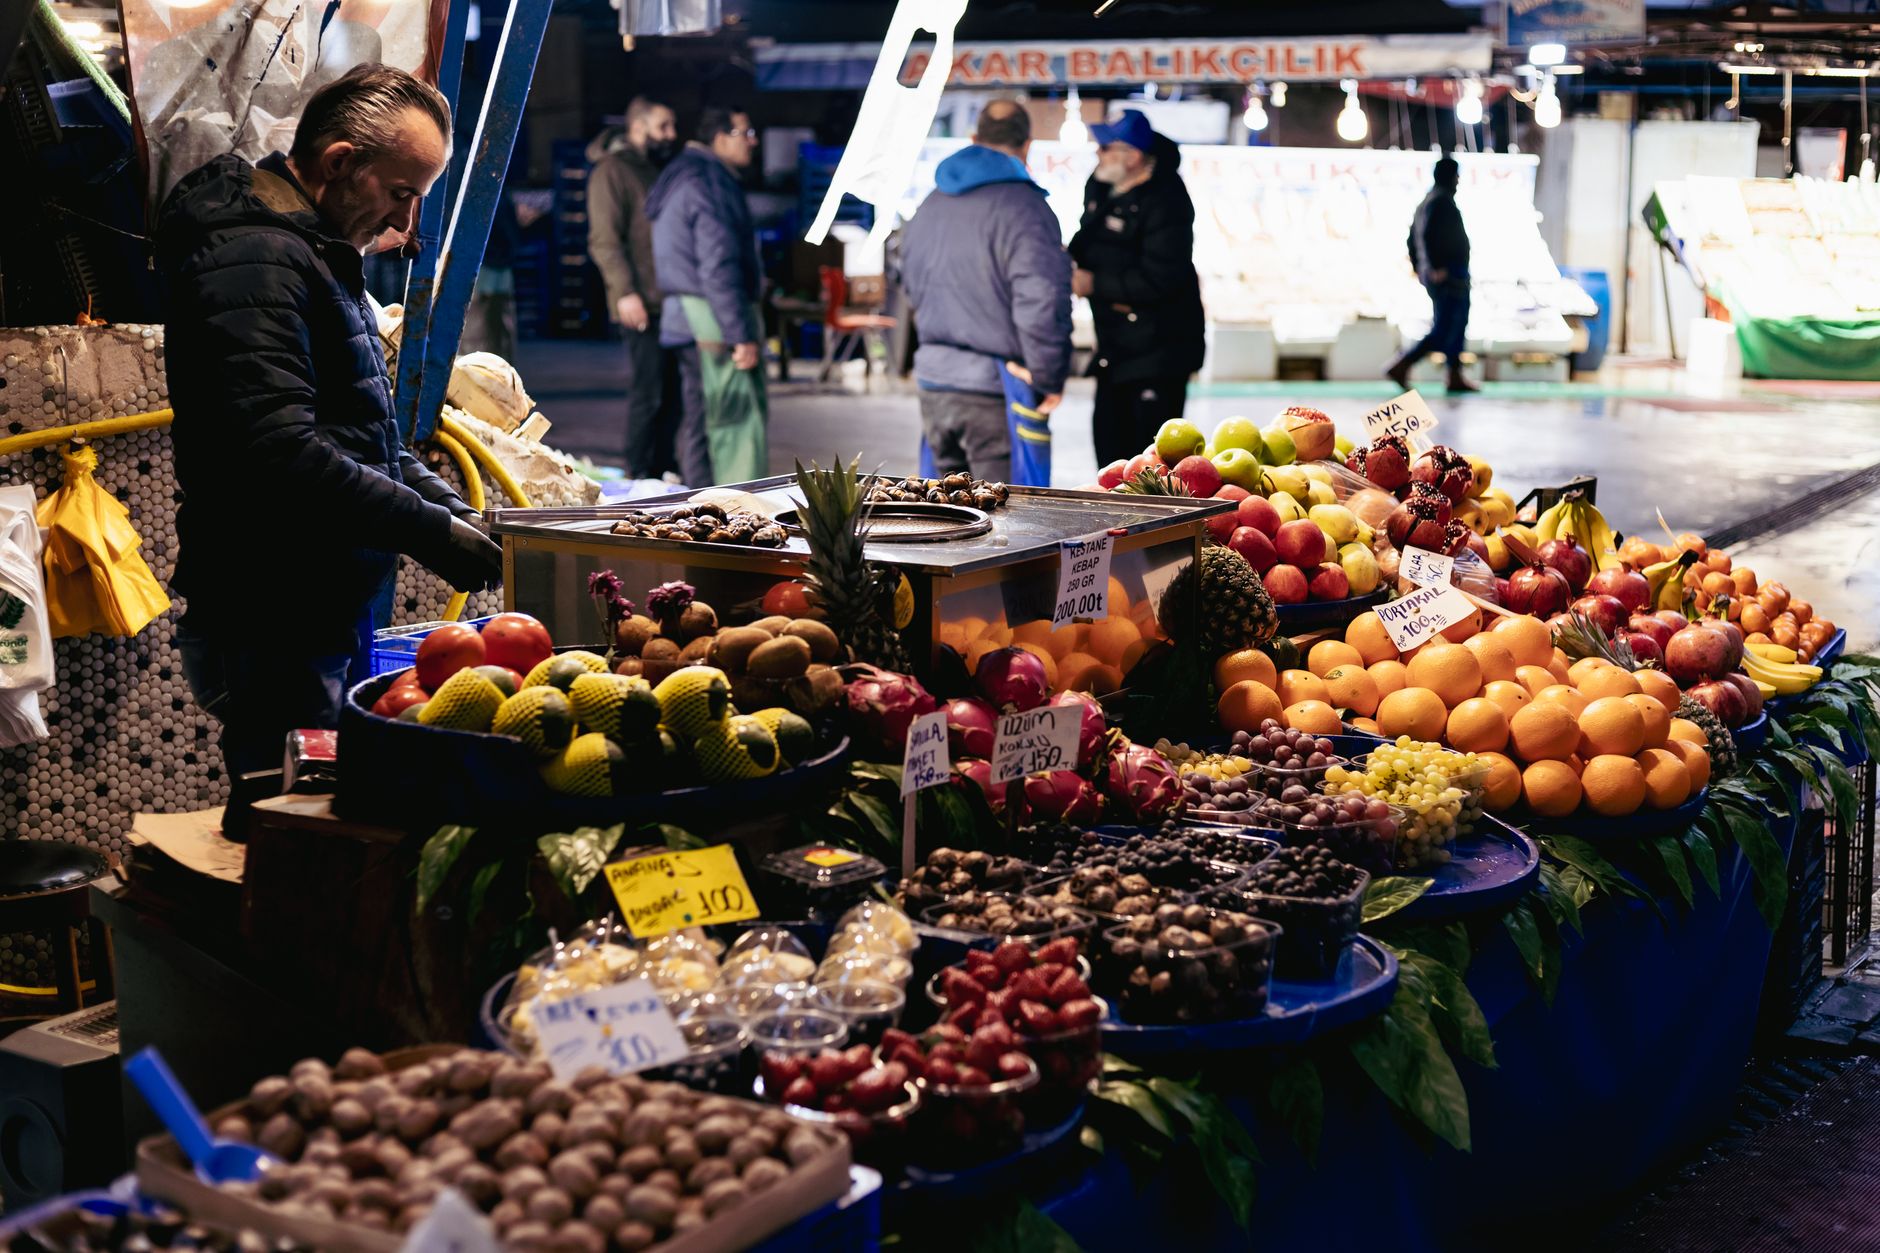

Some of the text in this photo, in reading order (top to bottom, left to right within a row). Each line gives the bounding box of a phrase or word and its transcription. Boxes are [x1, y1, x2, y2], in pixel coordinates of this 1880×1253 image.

[1071, 43, 1368, 80] BALIKÇILIK
[1367, 403, 1404, 426] AYVA
[1070, 538, 1107, 559] KESTANE
[1071, 557, 1100, 575] KEBAP
[1066, 574, 1095, 593] 250 GR
[1377, 587, 1448, 622] PORTAKAL
